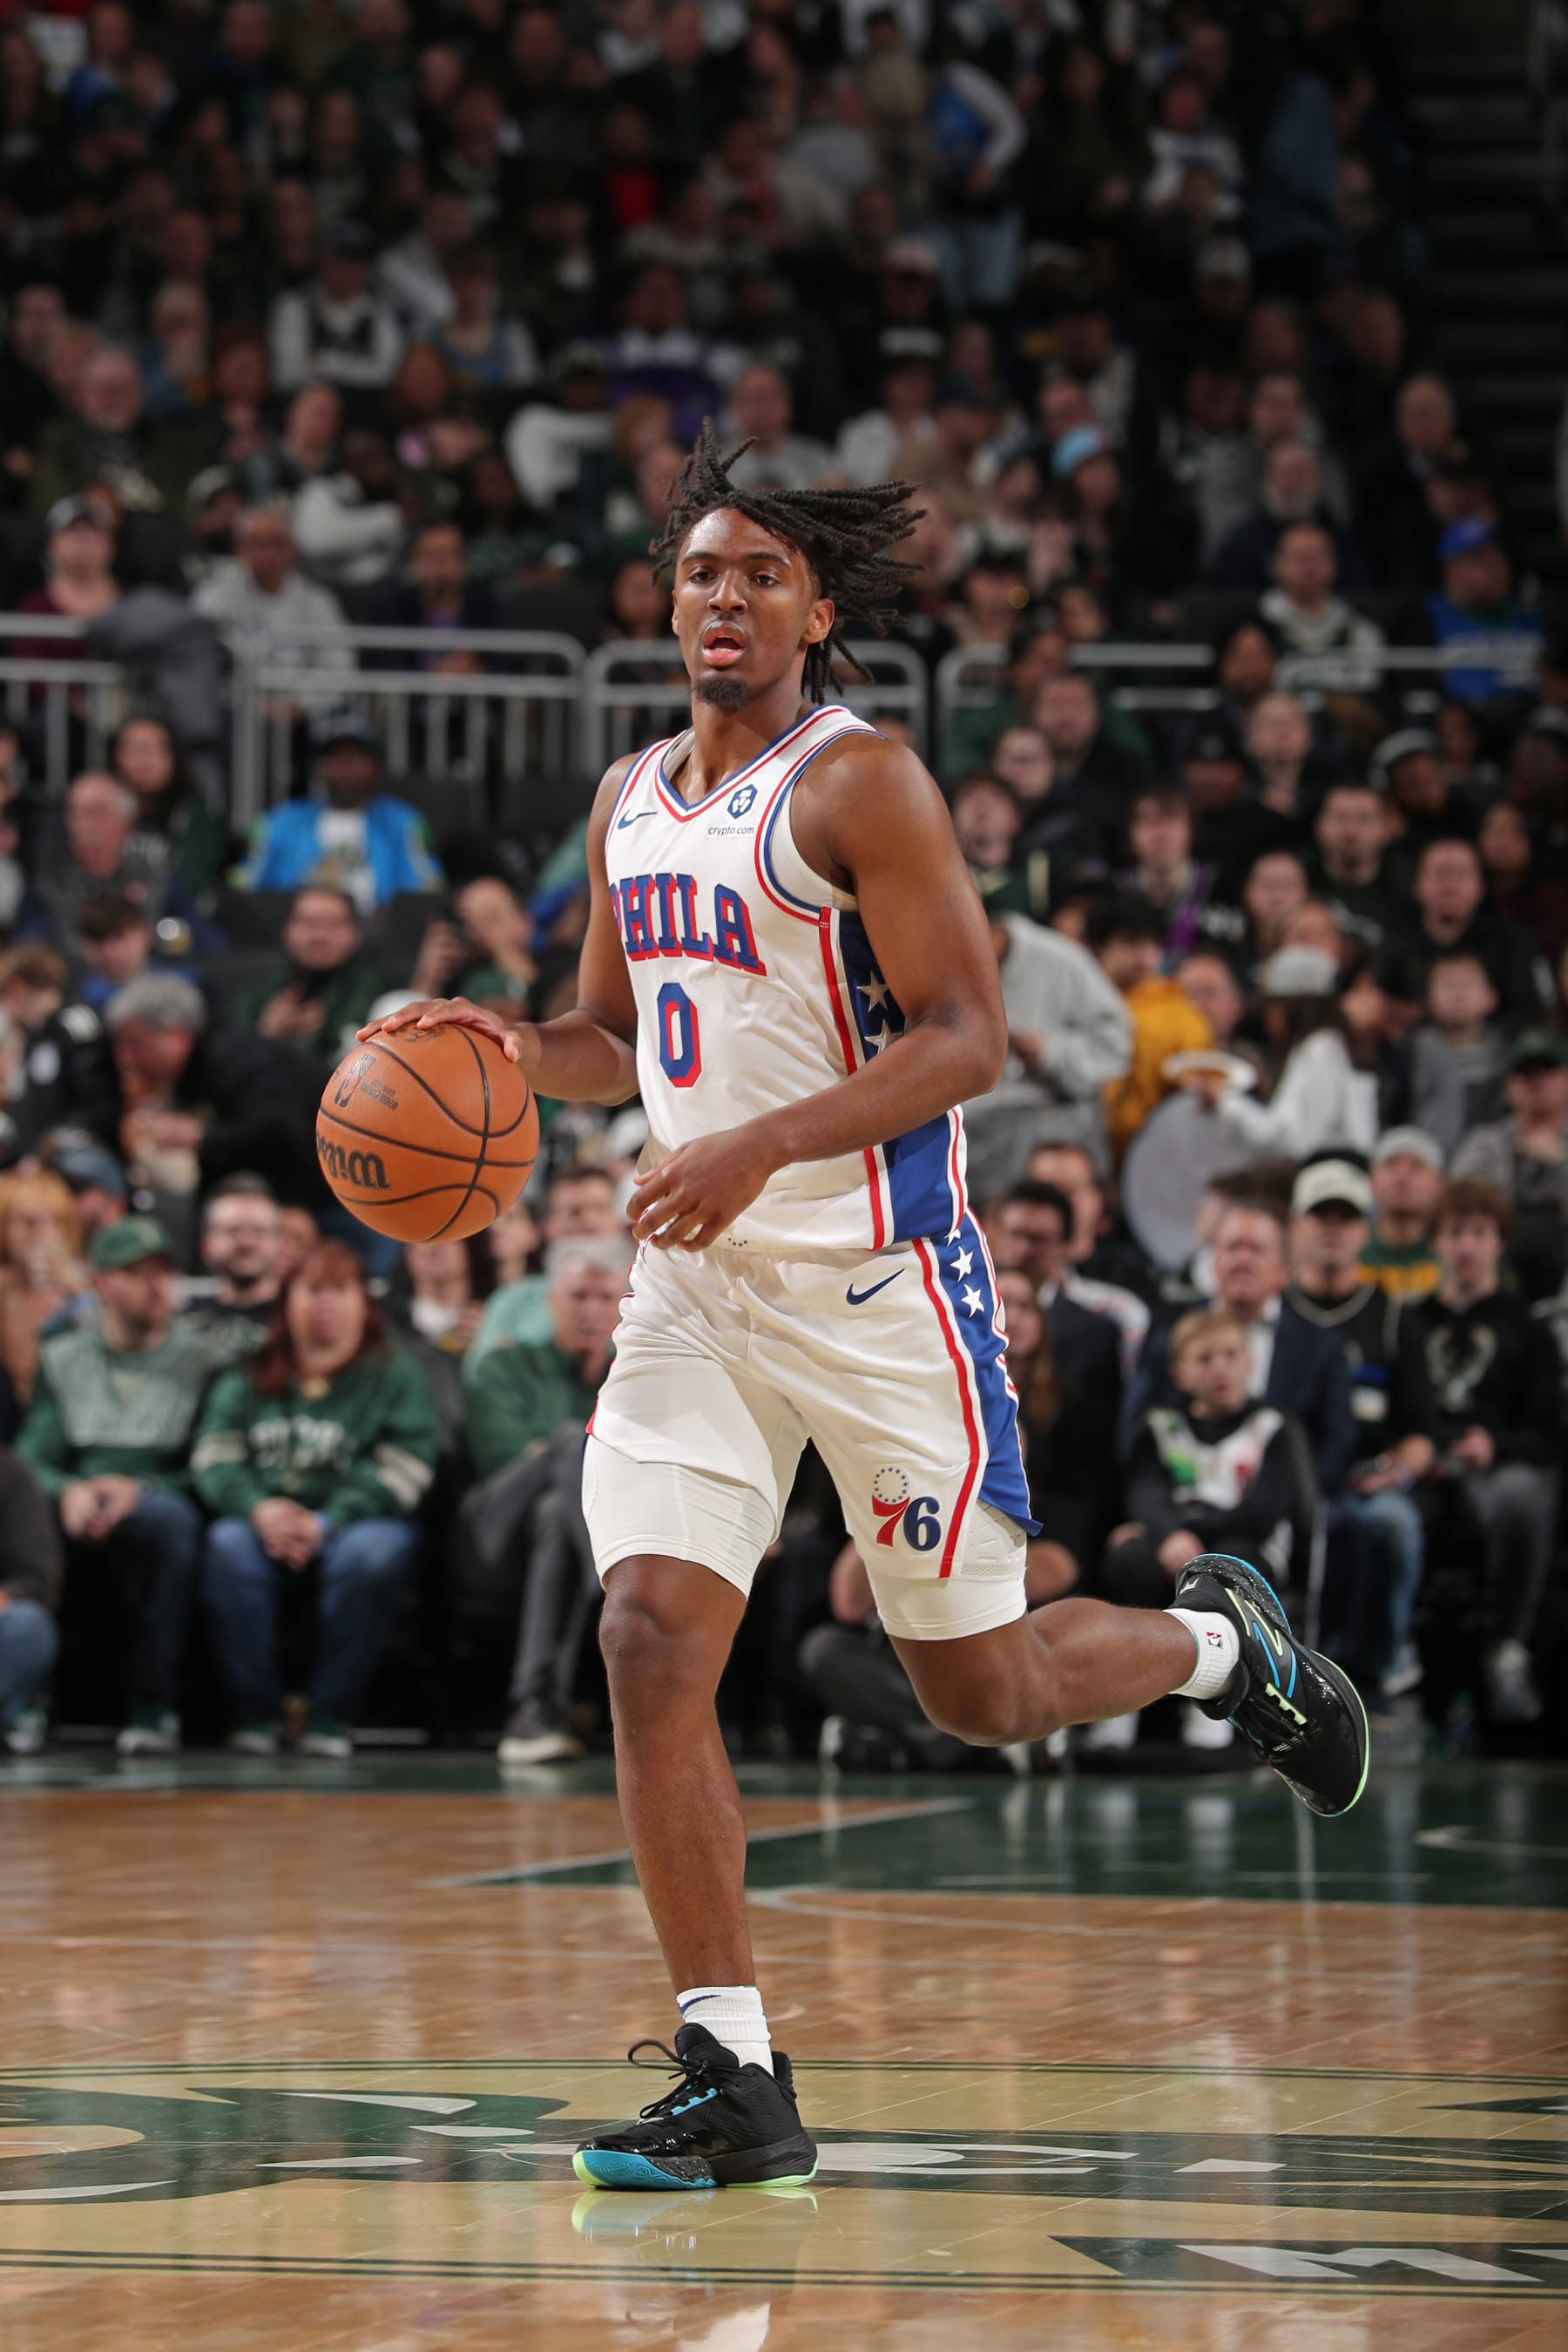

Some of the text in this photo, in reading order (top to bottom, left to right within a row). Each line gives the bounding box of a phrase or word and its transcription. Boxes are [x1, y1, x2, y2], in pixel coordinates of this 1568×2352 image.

[707, 826, 754, 836] crypto.com
[657, 983, 702, 1087] 0
[872, 1493, 942, 1551] 76
